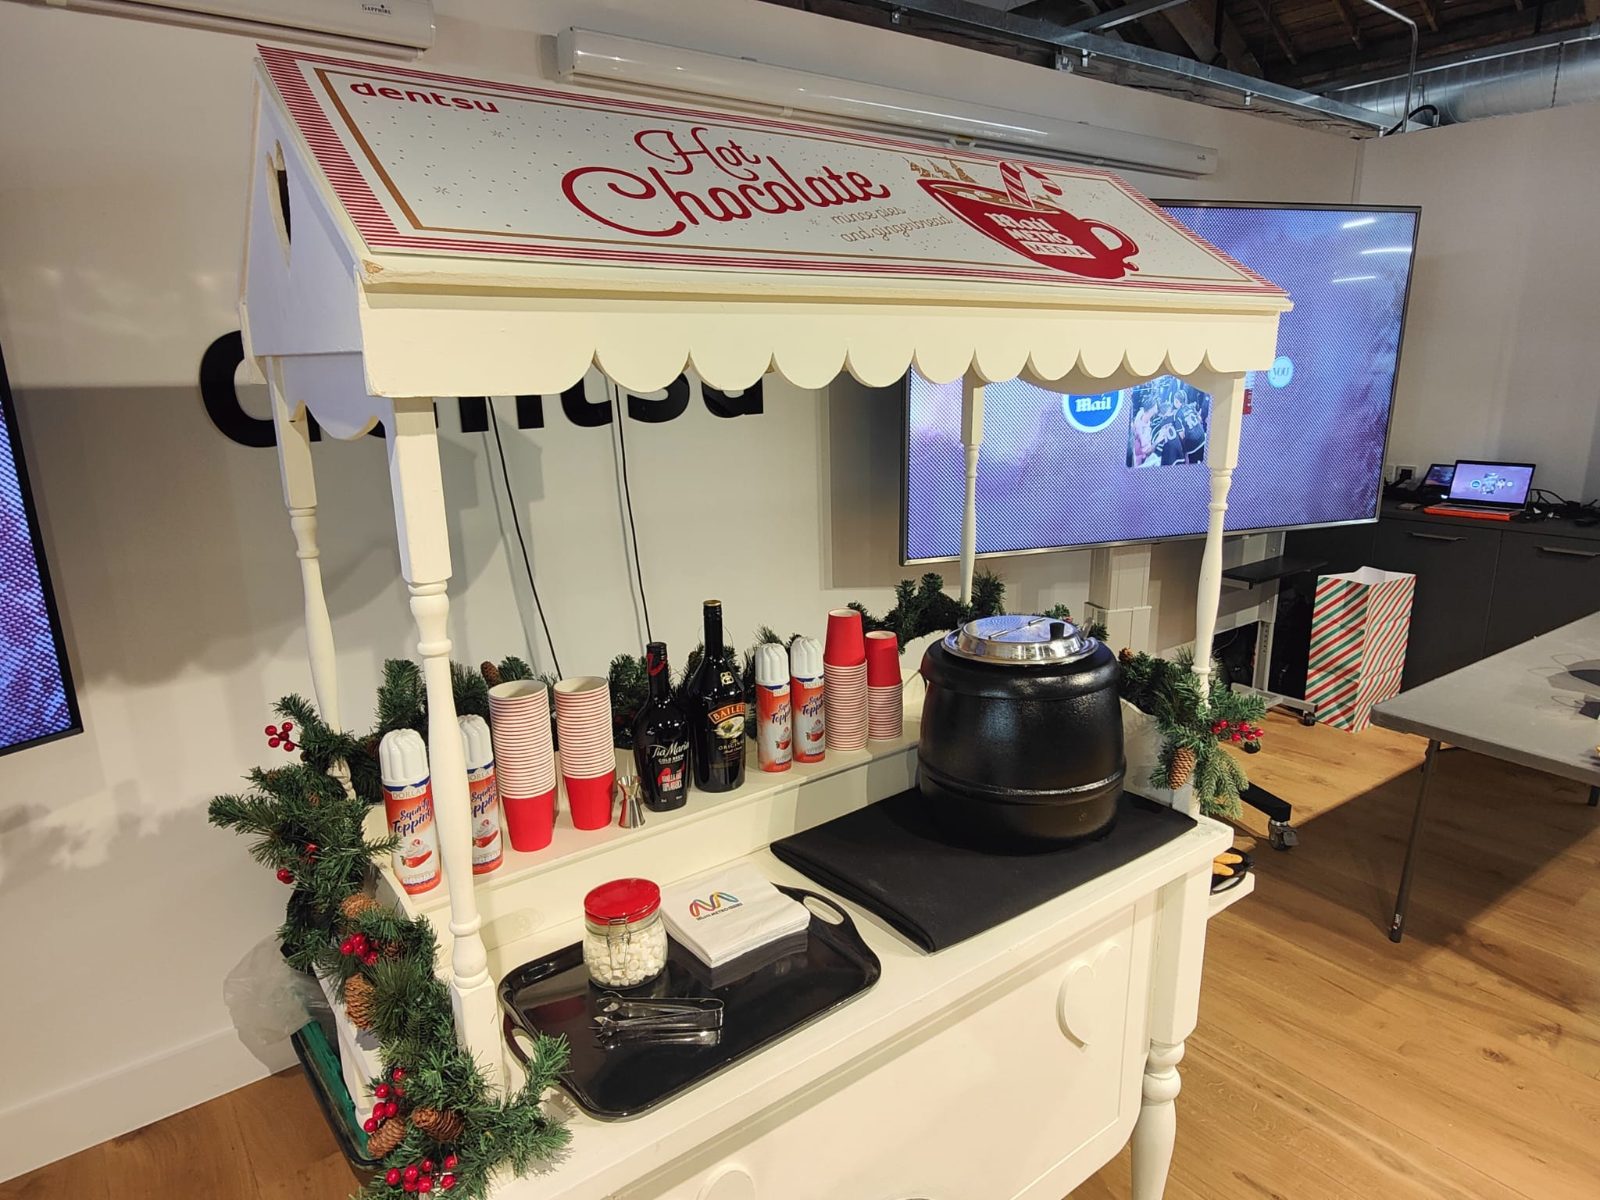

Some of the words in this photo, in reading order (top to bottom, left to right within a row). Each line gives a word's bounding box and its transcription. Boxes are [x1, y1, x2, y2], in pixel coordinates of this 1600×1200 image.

[350, 82, 500, 114] dentsu
[633, 126, 762, 181] Hot
[561, 154, 891, 237] Chocolate
[831, 210, 878, 224] mince
[984, 212, 1059, 233] Mail
[840, 226, 875, 242] and
[872, 212, 953, 241] gingerbread
[1004, 228, 1074, 245] METRO
[1022, 242, 1091, 256] MEDIA
[1075, 394, 1111, 412] Mail
[650, 744, 668, 758] Tia
